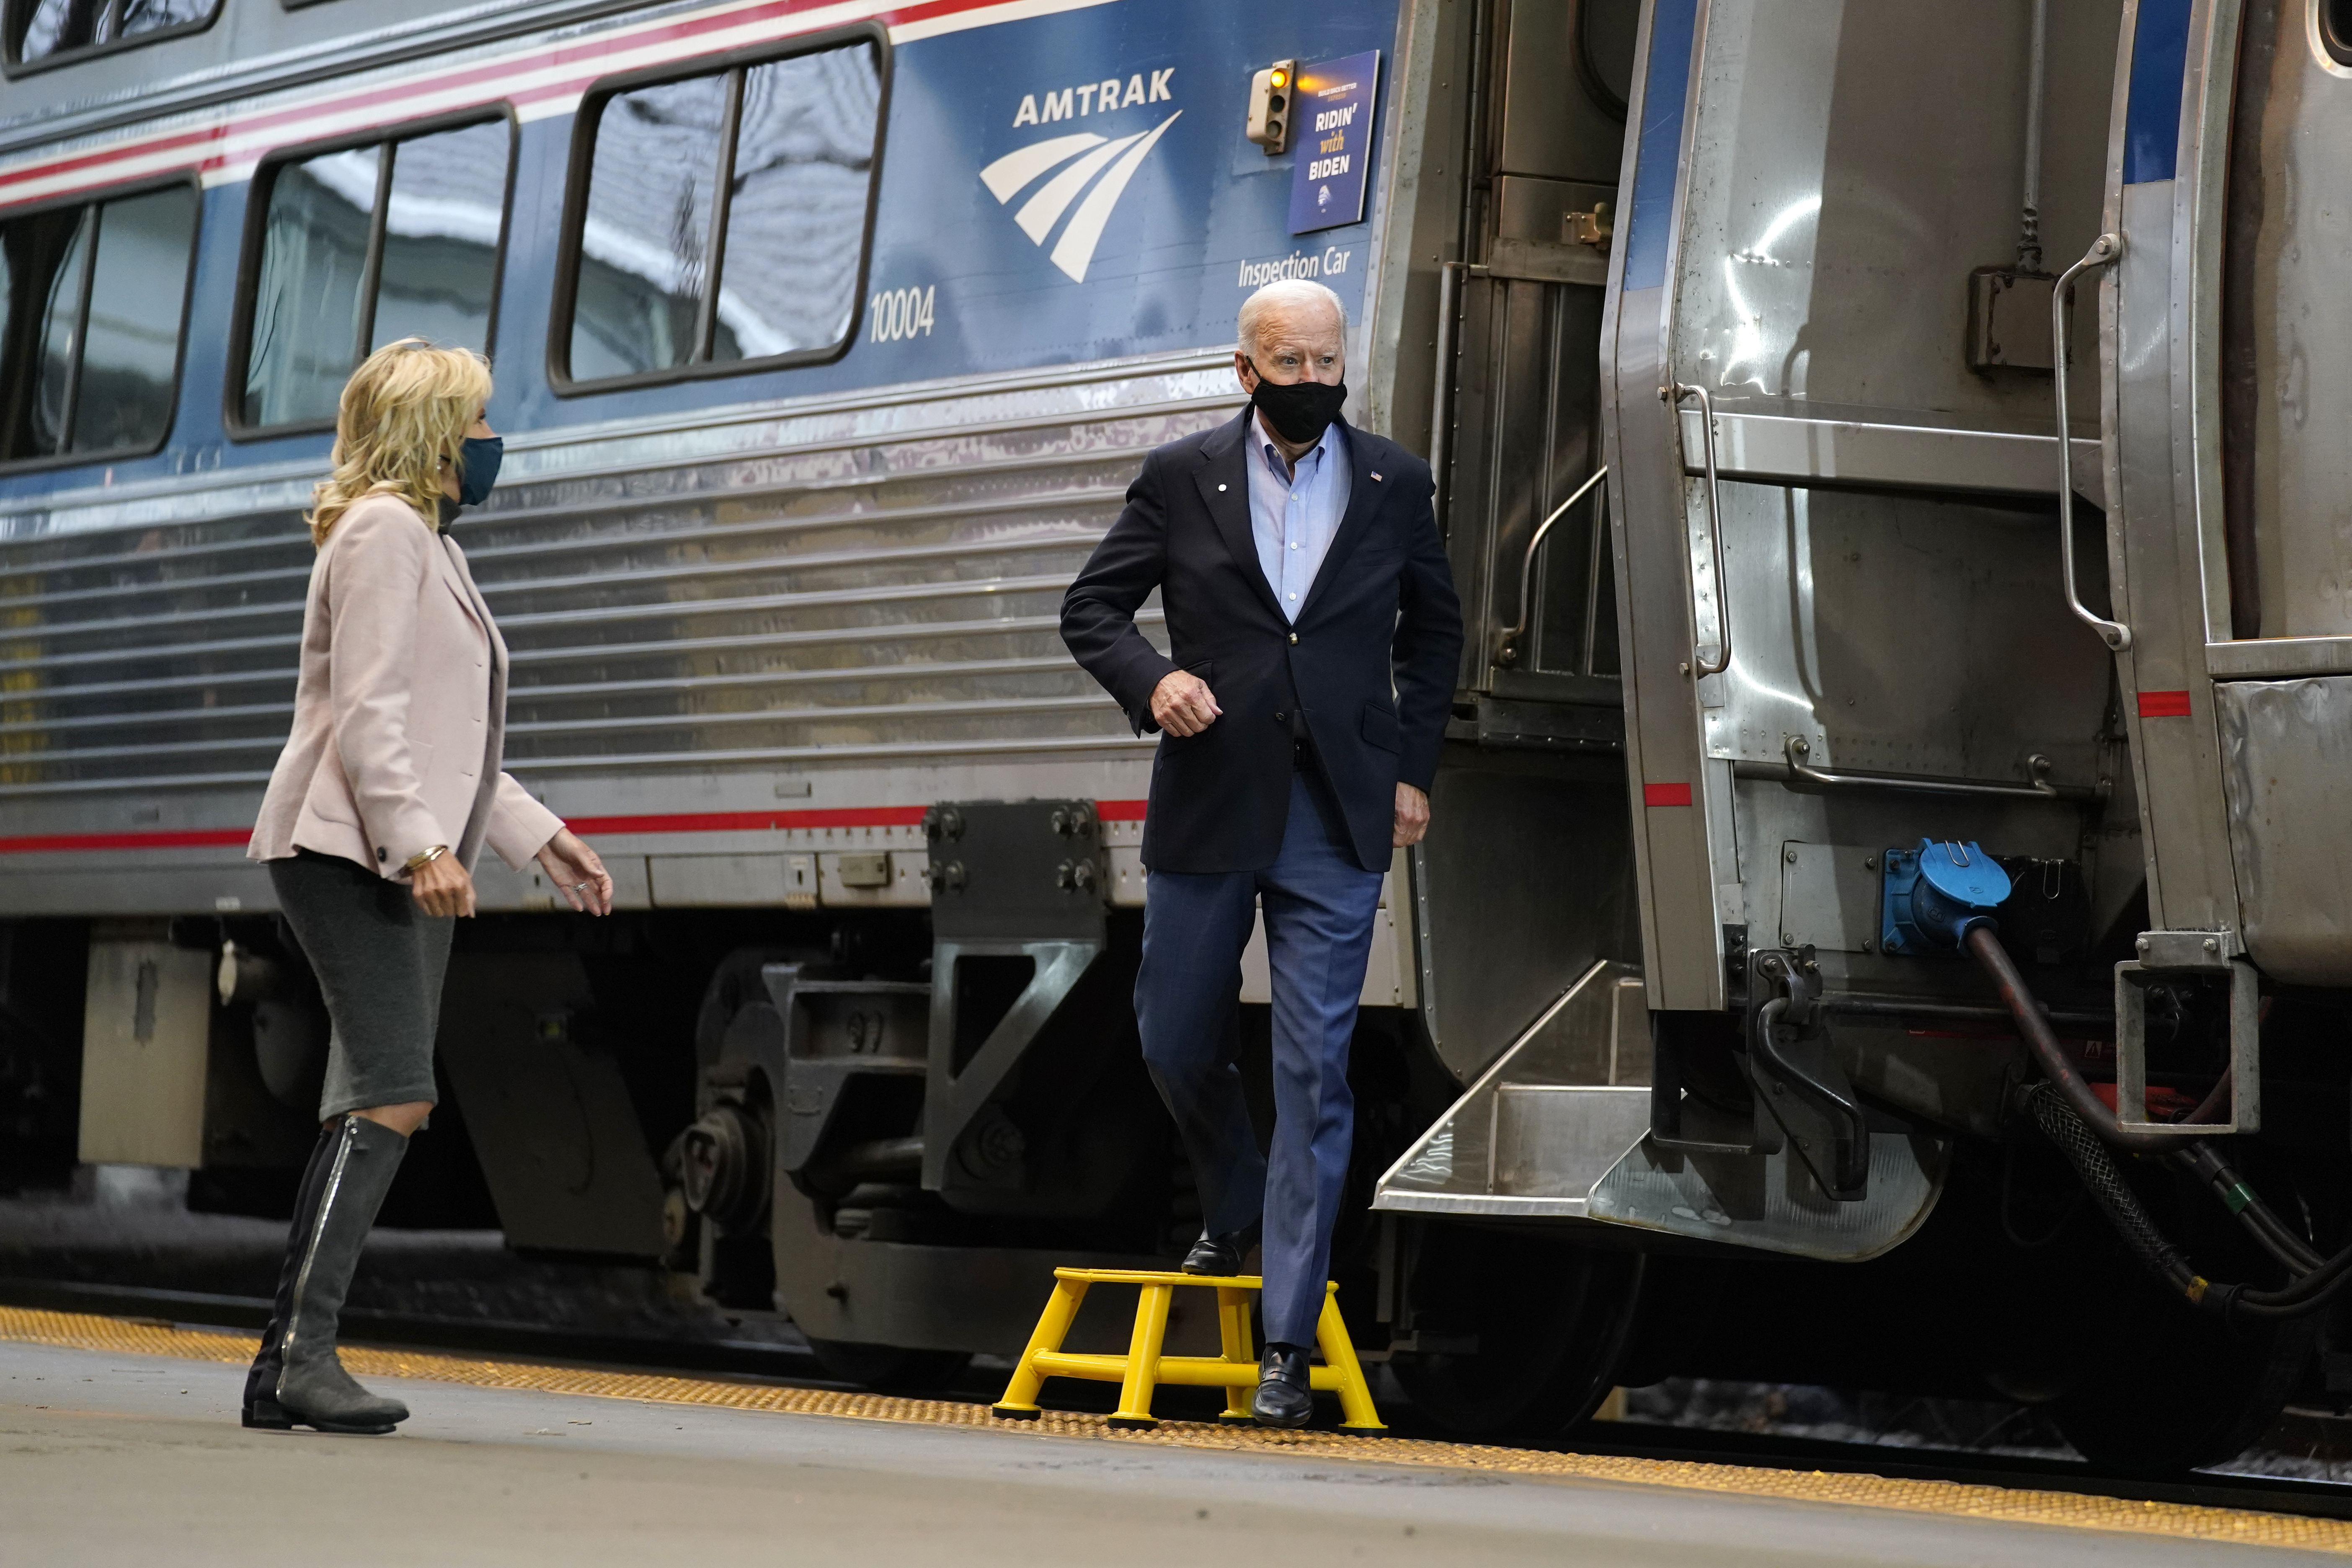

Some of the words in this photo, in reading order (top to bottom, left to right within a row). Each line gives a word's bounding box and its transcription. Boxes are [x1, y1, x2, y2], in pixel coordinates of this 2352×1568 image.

[1012, 67, 1175, 128] AMTRAK
[1315, 102, 1358, 132] RIDIN'
[1320, 129, 1345, 155] with
[1308, 154, 1350, 181] BIDEN
[1238, 250, 1319, 289] Inspection
[1323, 246, 1351, 276] Car
[870, 284, 935, 344] 10004
